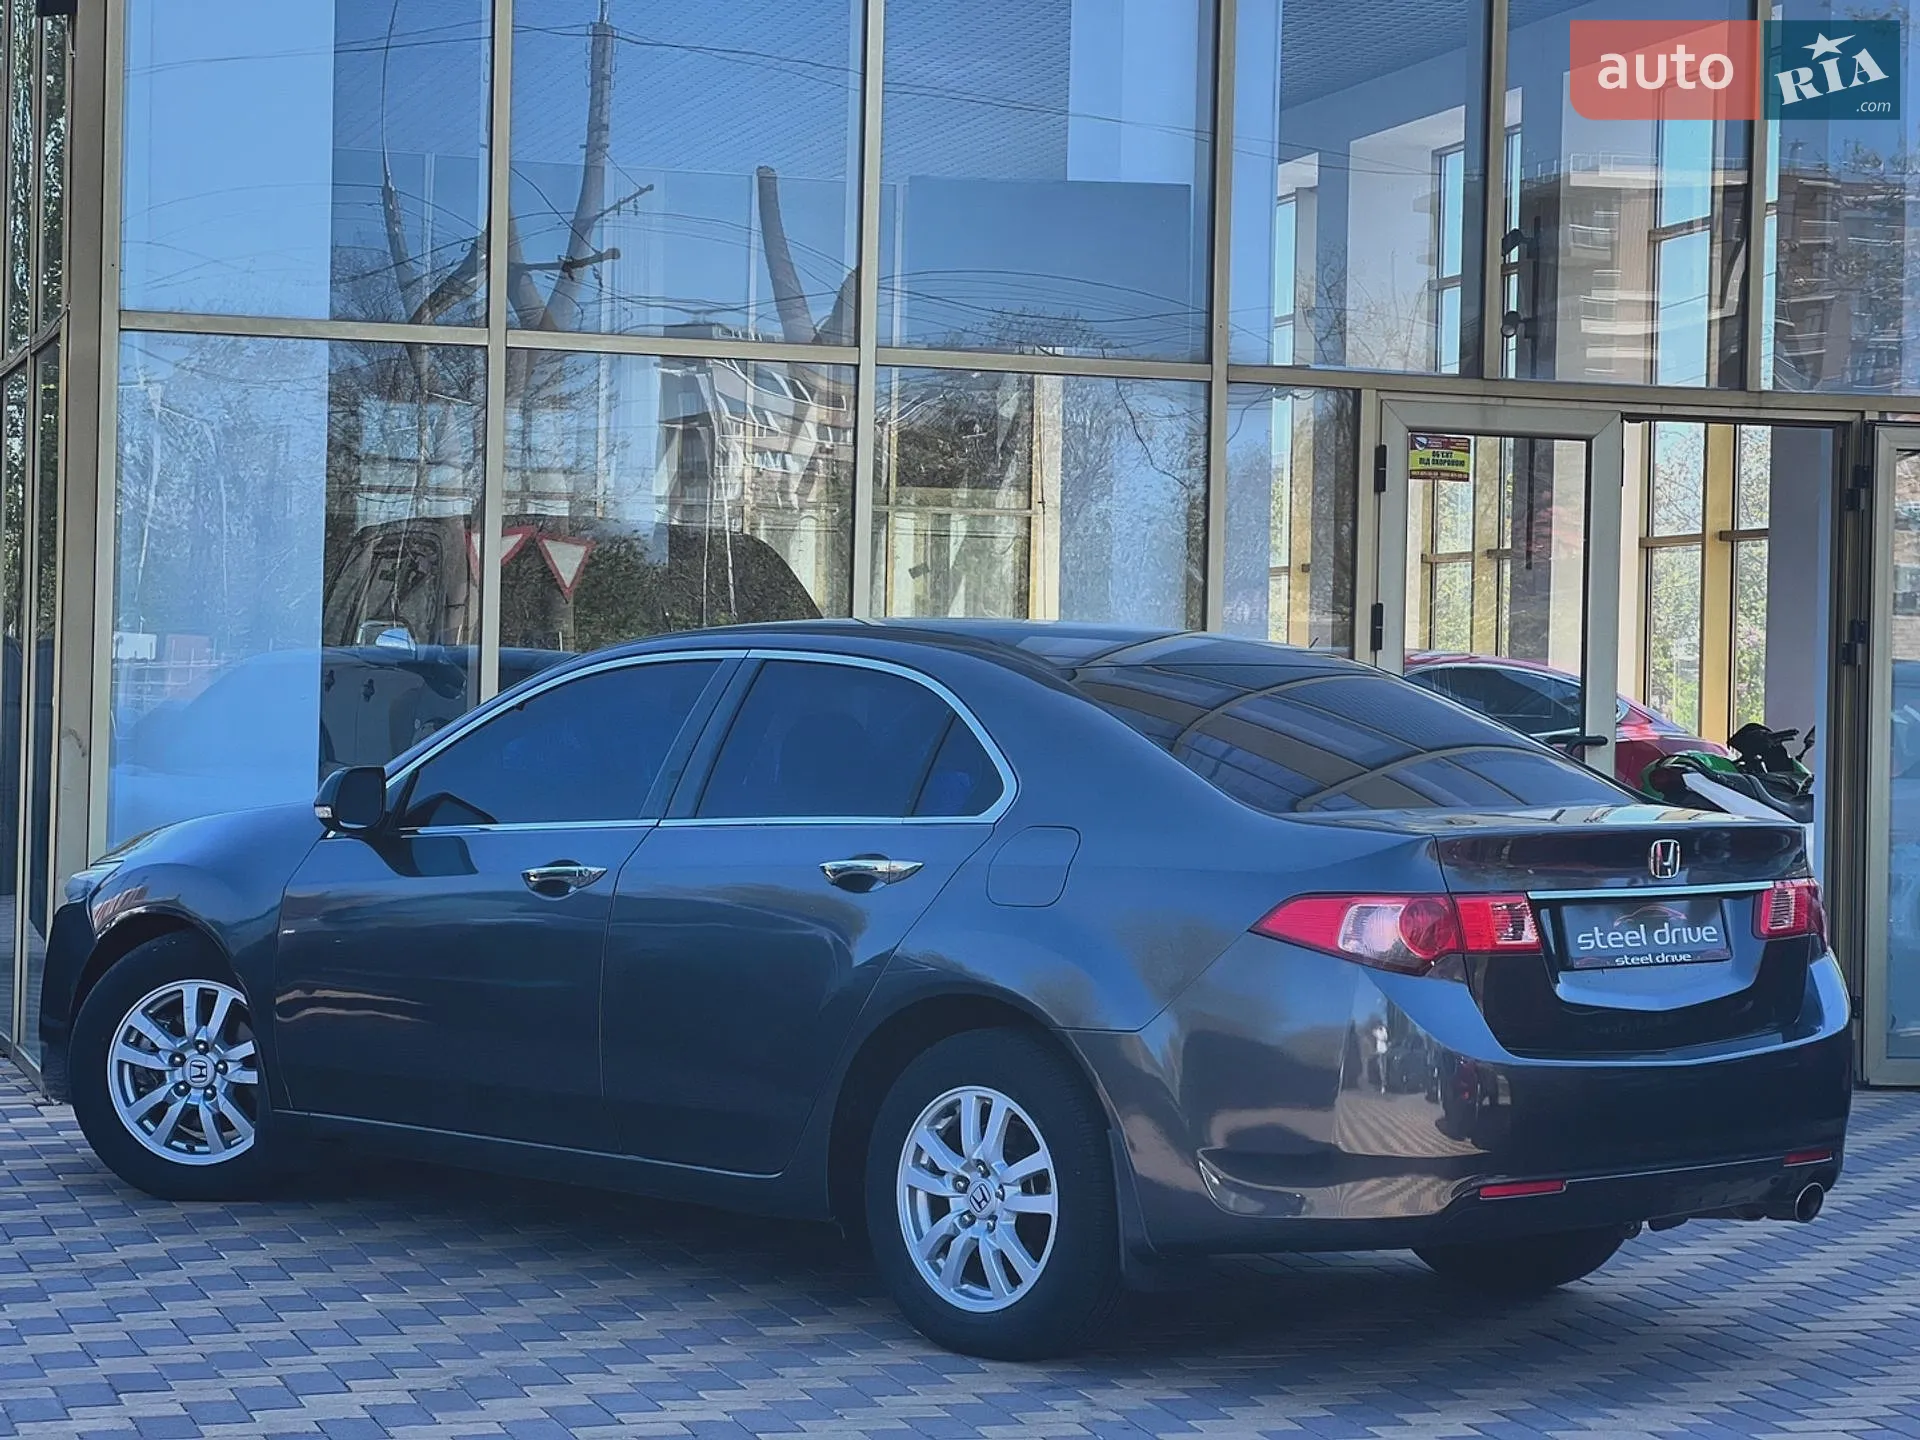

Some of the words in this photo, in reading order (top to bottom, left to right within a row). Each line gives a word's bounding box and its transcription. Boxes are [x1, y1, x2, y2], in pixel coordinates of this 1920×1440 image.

[1577, 924, 1648, 951] steel
[1653, 922, 1718, 945] drive
[1615, 954, 1653, 966] steel
[1657, 953, 1692, 963] drive
